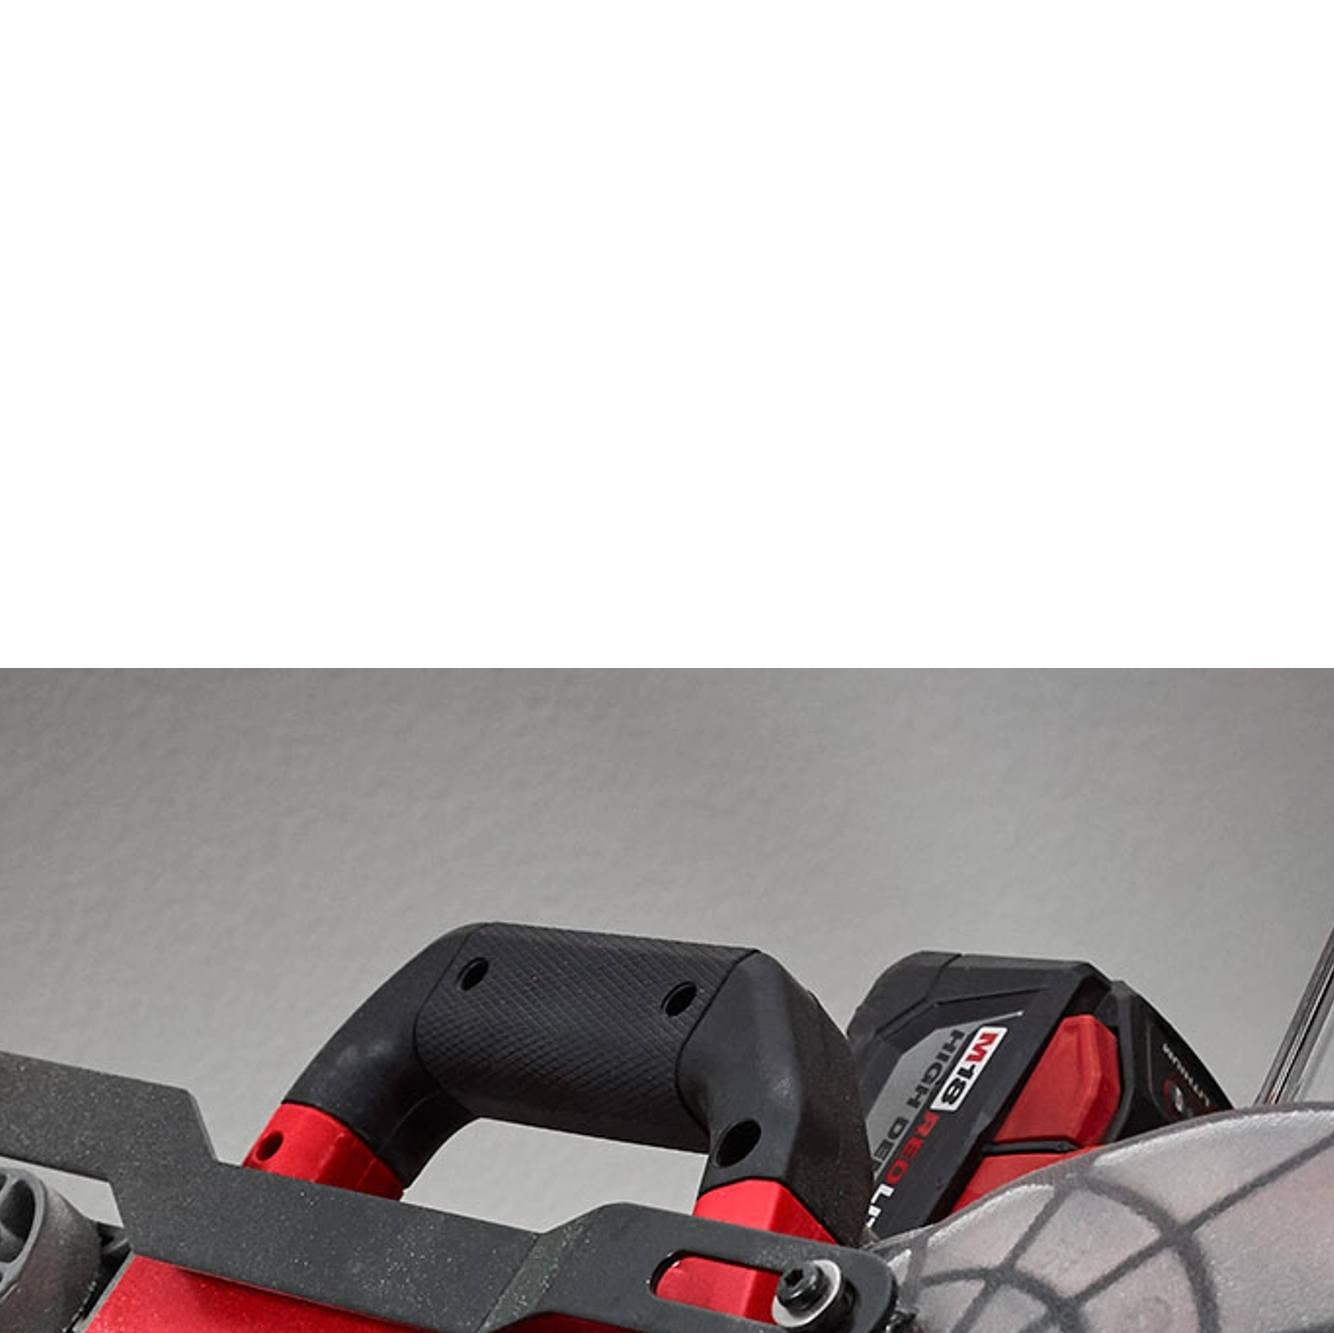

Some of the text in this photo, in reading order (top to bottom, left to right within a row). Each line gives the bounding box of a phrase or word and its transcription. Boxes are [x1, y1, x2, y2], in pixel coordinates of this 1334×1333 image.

[869, 1028, 966, 1172] HIGH DE
[940, 1030, 1000, 1105] M18
